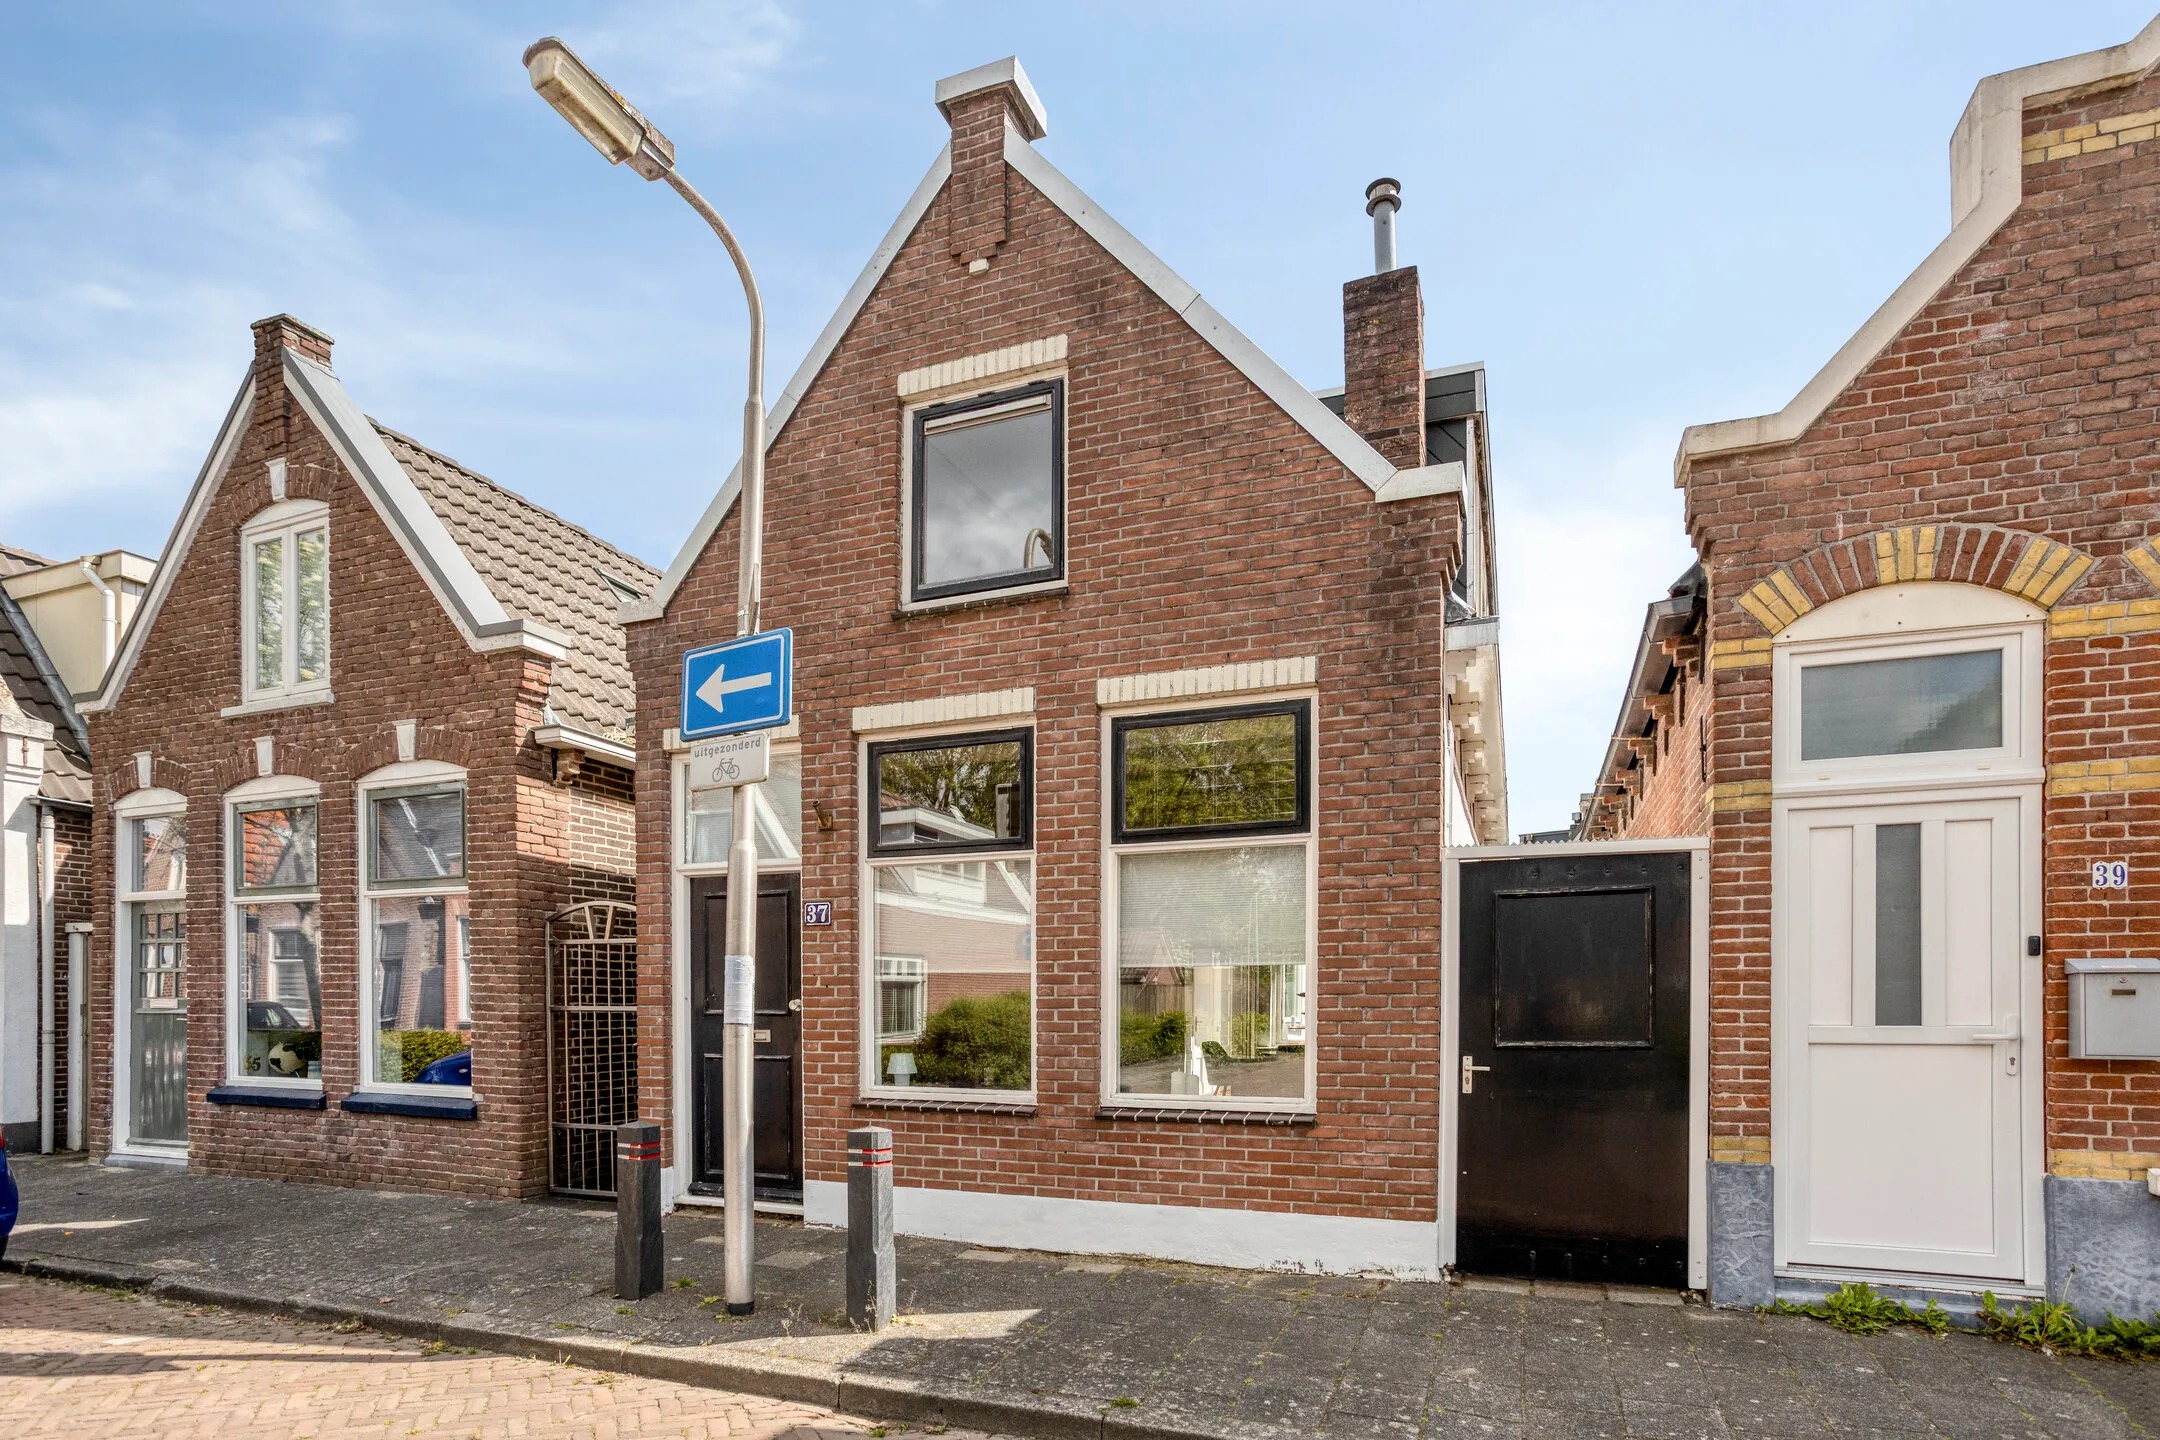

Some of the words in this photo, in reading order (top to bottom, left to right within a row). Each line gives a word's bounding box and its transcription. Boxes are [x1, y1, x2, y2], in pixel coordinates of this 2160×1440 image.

[694, 738, 761, 758] uitgezonderd
[2095, 864, 2126, 887] 39
[806, 905, 828, 922] 37
